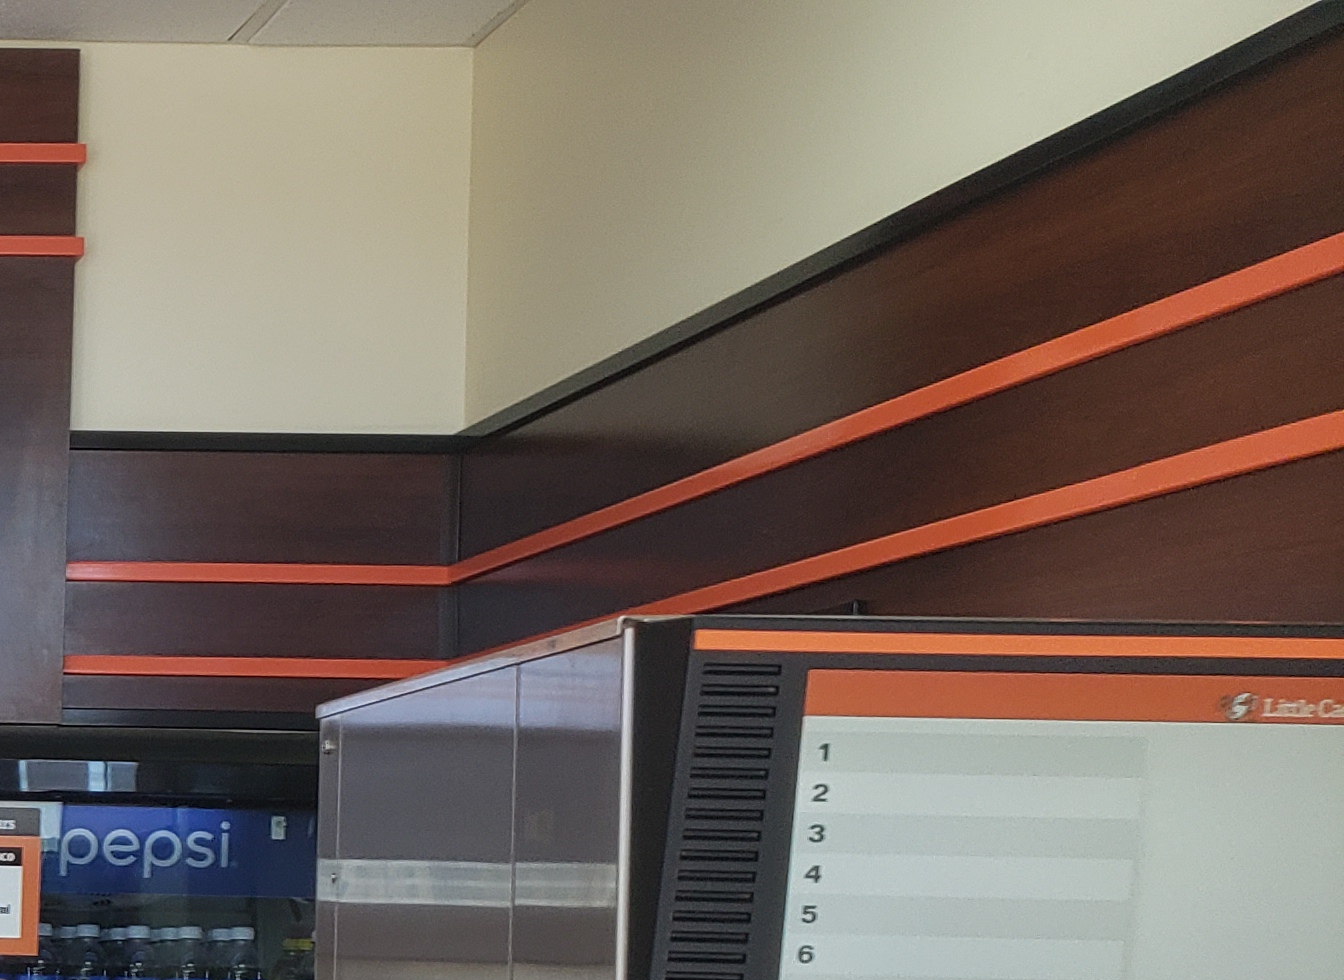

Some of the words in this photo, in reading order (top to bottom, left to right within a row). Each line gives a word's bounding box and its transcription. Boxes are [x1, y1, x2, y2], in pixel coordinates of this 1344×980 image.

[819, 743, 831, 761] 1
[811, 784, 830, 802] 2
[807, 825, 826, 843] 3
[59, 821, 232, 879] pepsi
[804, 865, 822, 883] 4
[801, 906, 818, 924] 5
[797, 946, 815, 964] 6
